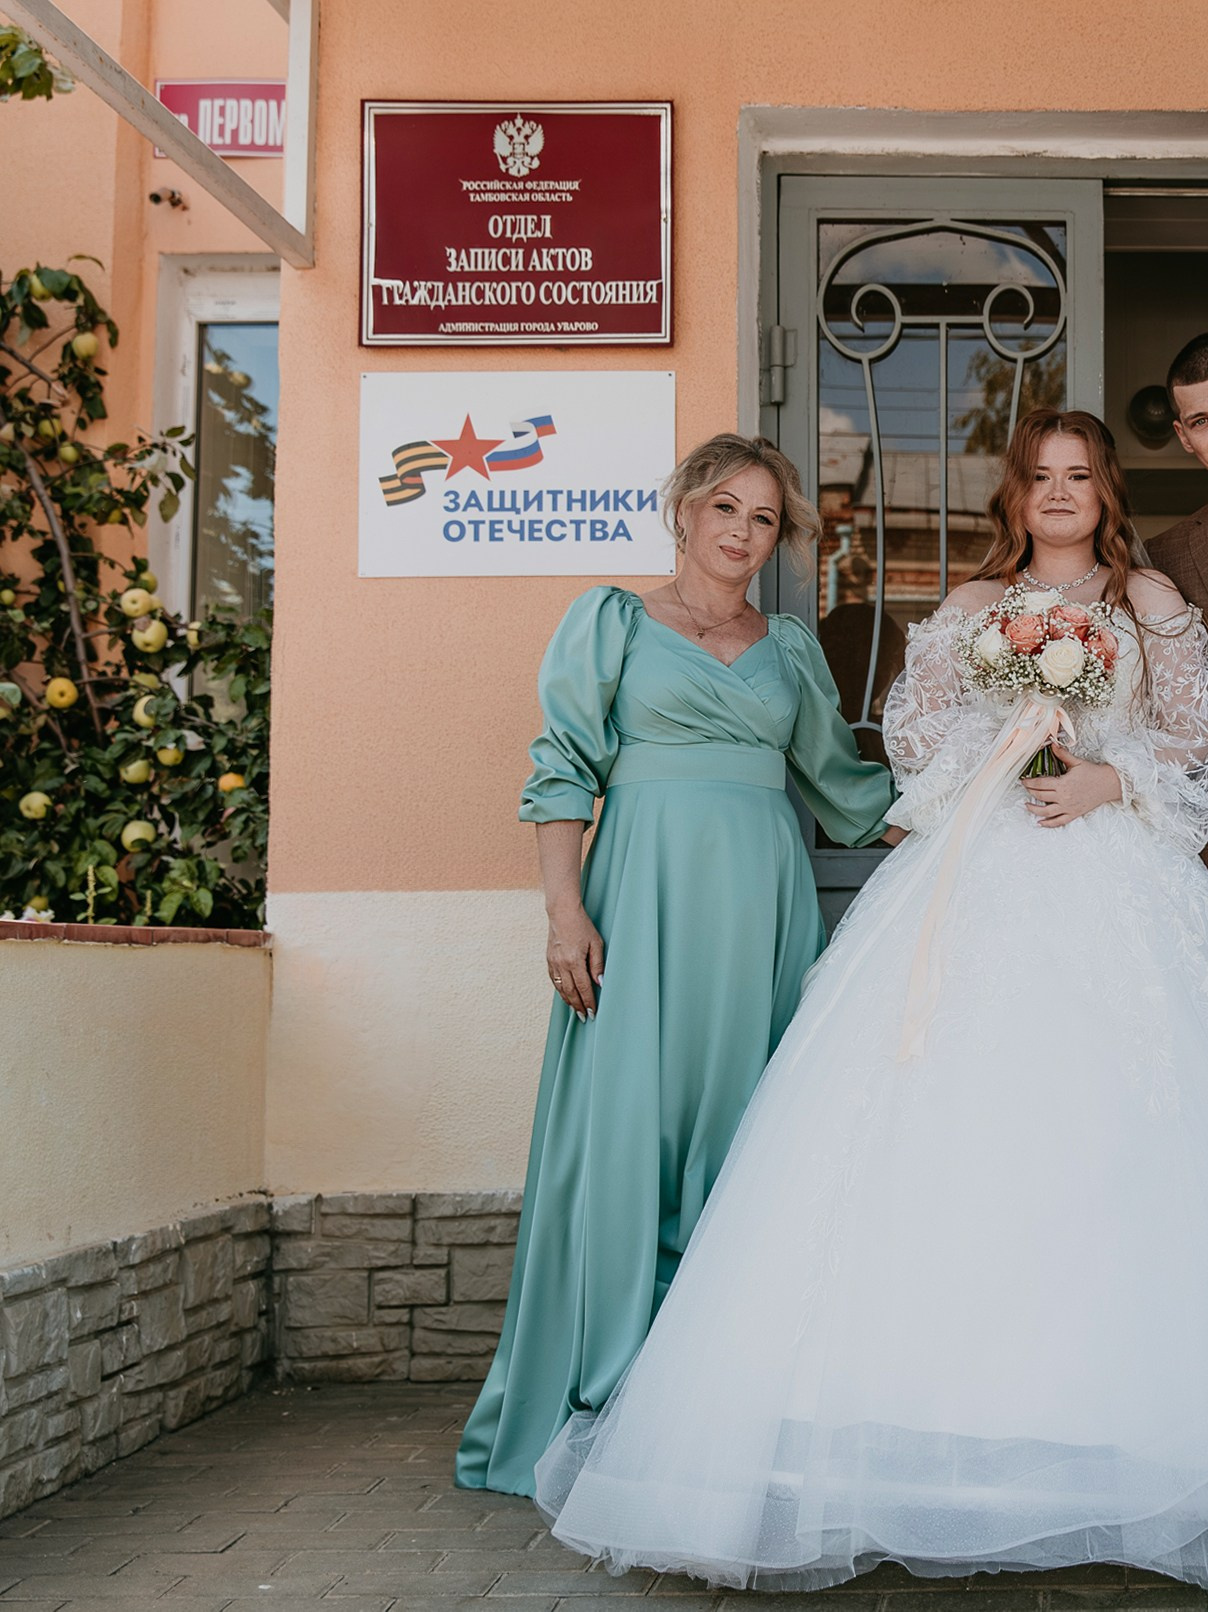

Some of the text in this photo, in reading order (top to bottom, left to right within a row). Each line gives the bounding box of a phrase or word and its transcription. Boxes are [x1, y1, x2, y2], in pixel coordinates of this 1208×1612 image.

[460, 180, 580, 191] РОССИЙСКАЯ ФЕДЕРАЦИЯ
[469, 192, 573, 202] ТАМБОВСКАЯ ОБЛАСТЬ
[488, 215, 552, 242] ОТДЕЛ
[446, 247, 592, 271] ЗАПИСИ АКТОВ
[382, 280, 658, 310] ГРАЖДАНСКОГО СОСТОЯНИЯ
[439, 321, 599, 332] АДМИНИСТРАЦИЯ ГОРОДА УВАРОВО
[443, 490, 658, 515] ЗАЩИТНИКИ
[443, 519, 633, 542] ОТЕЧЕСТВА
